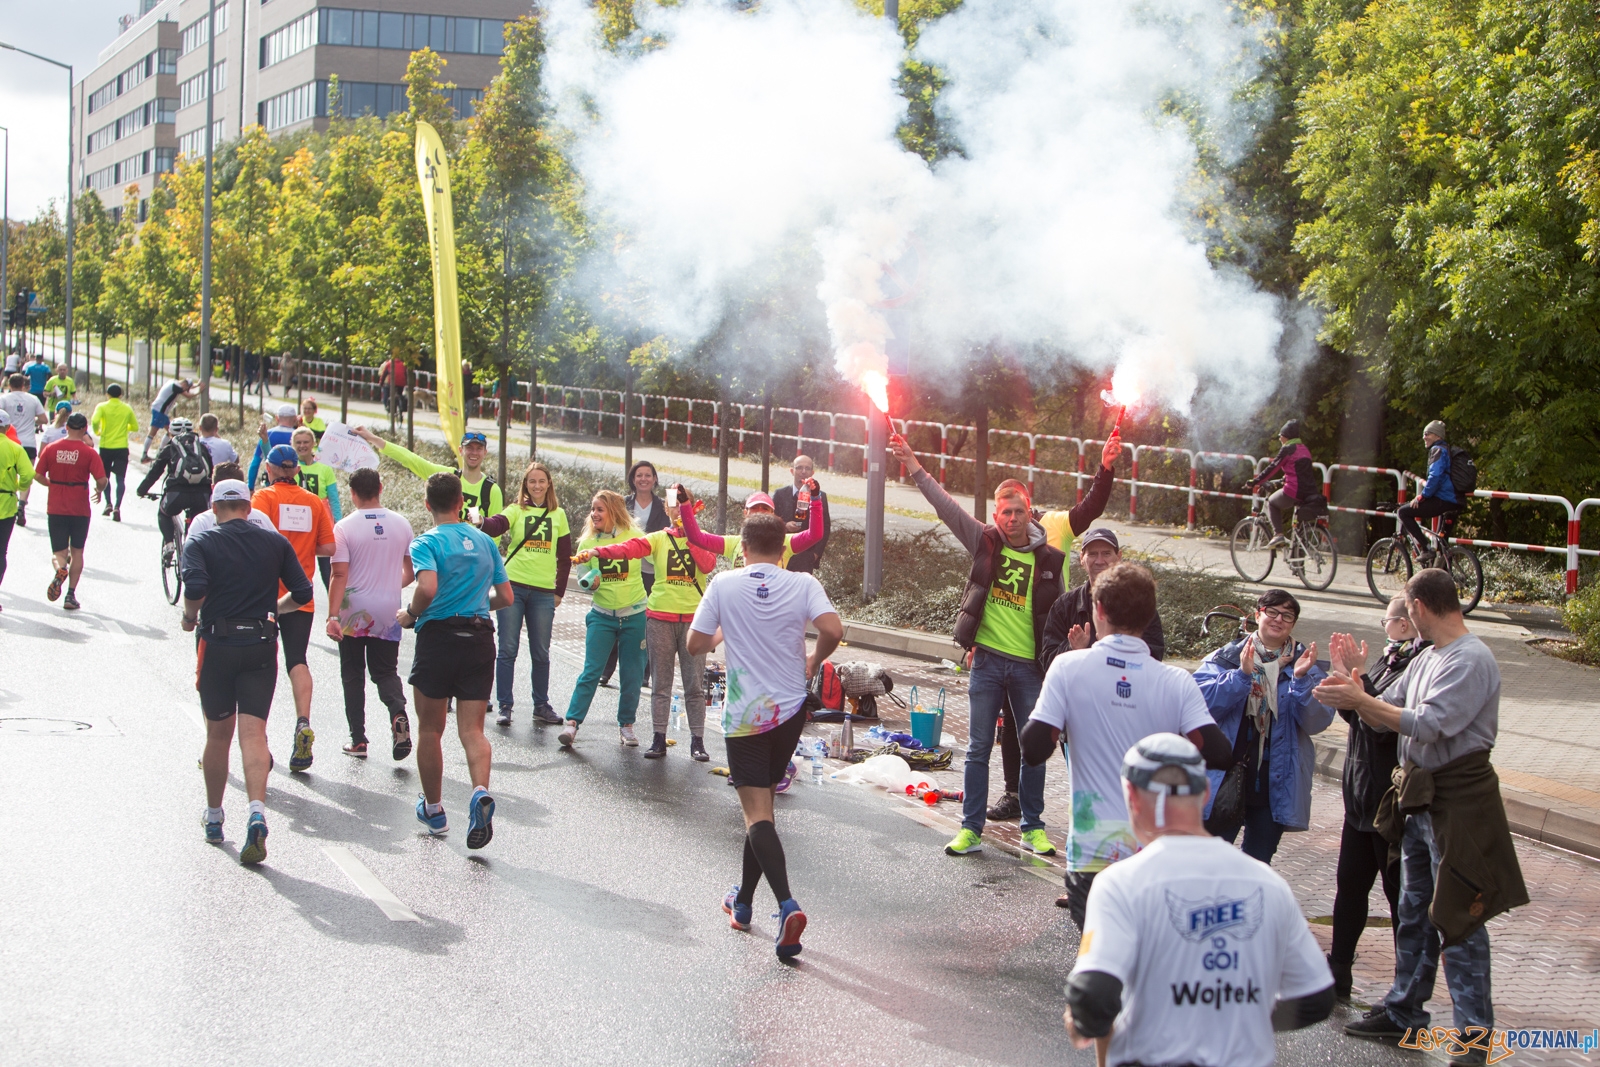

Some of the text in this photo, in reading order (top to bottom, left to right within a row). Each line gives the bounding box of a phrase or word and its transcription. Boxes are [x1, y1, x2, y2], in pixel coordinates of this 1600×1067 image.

[991, 597, 1025, 613] runners
[998, 590, 1020, 602] night
[1189, 900, 1244, 931] FREE
[1203, 951, 1239, 971] GO!
[1170, 977, 1261, 1010] Wojtek
